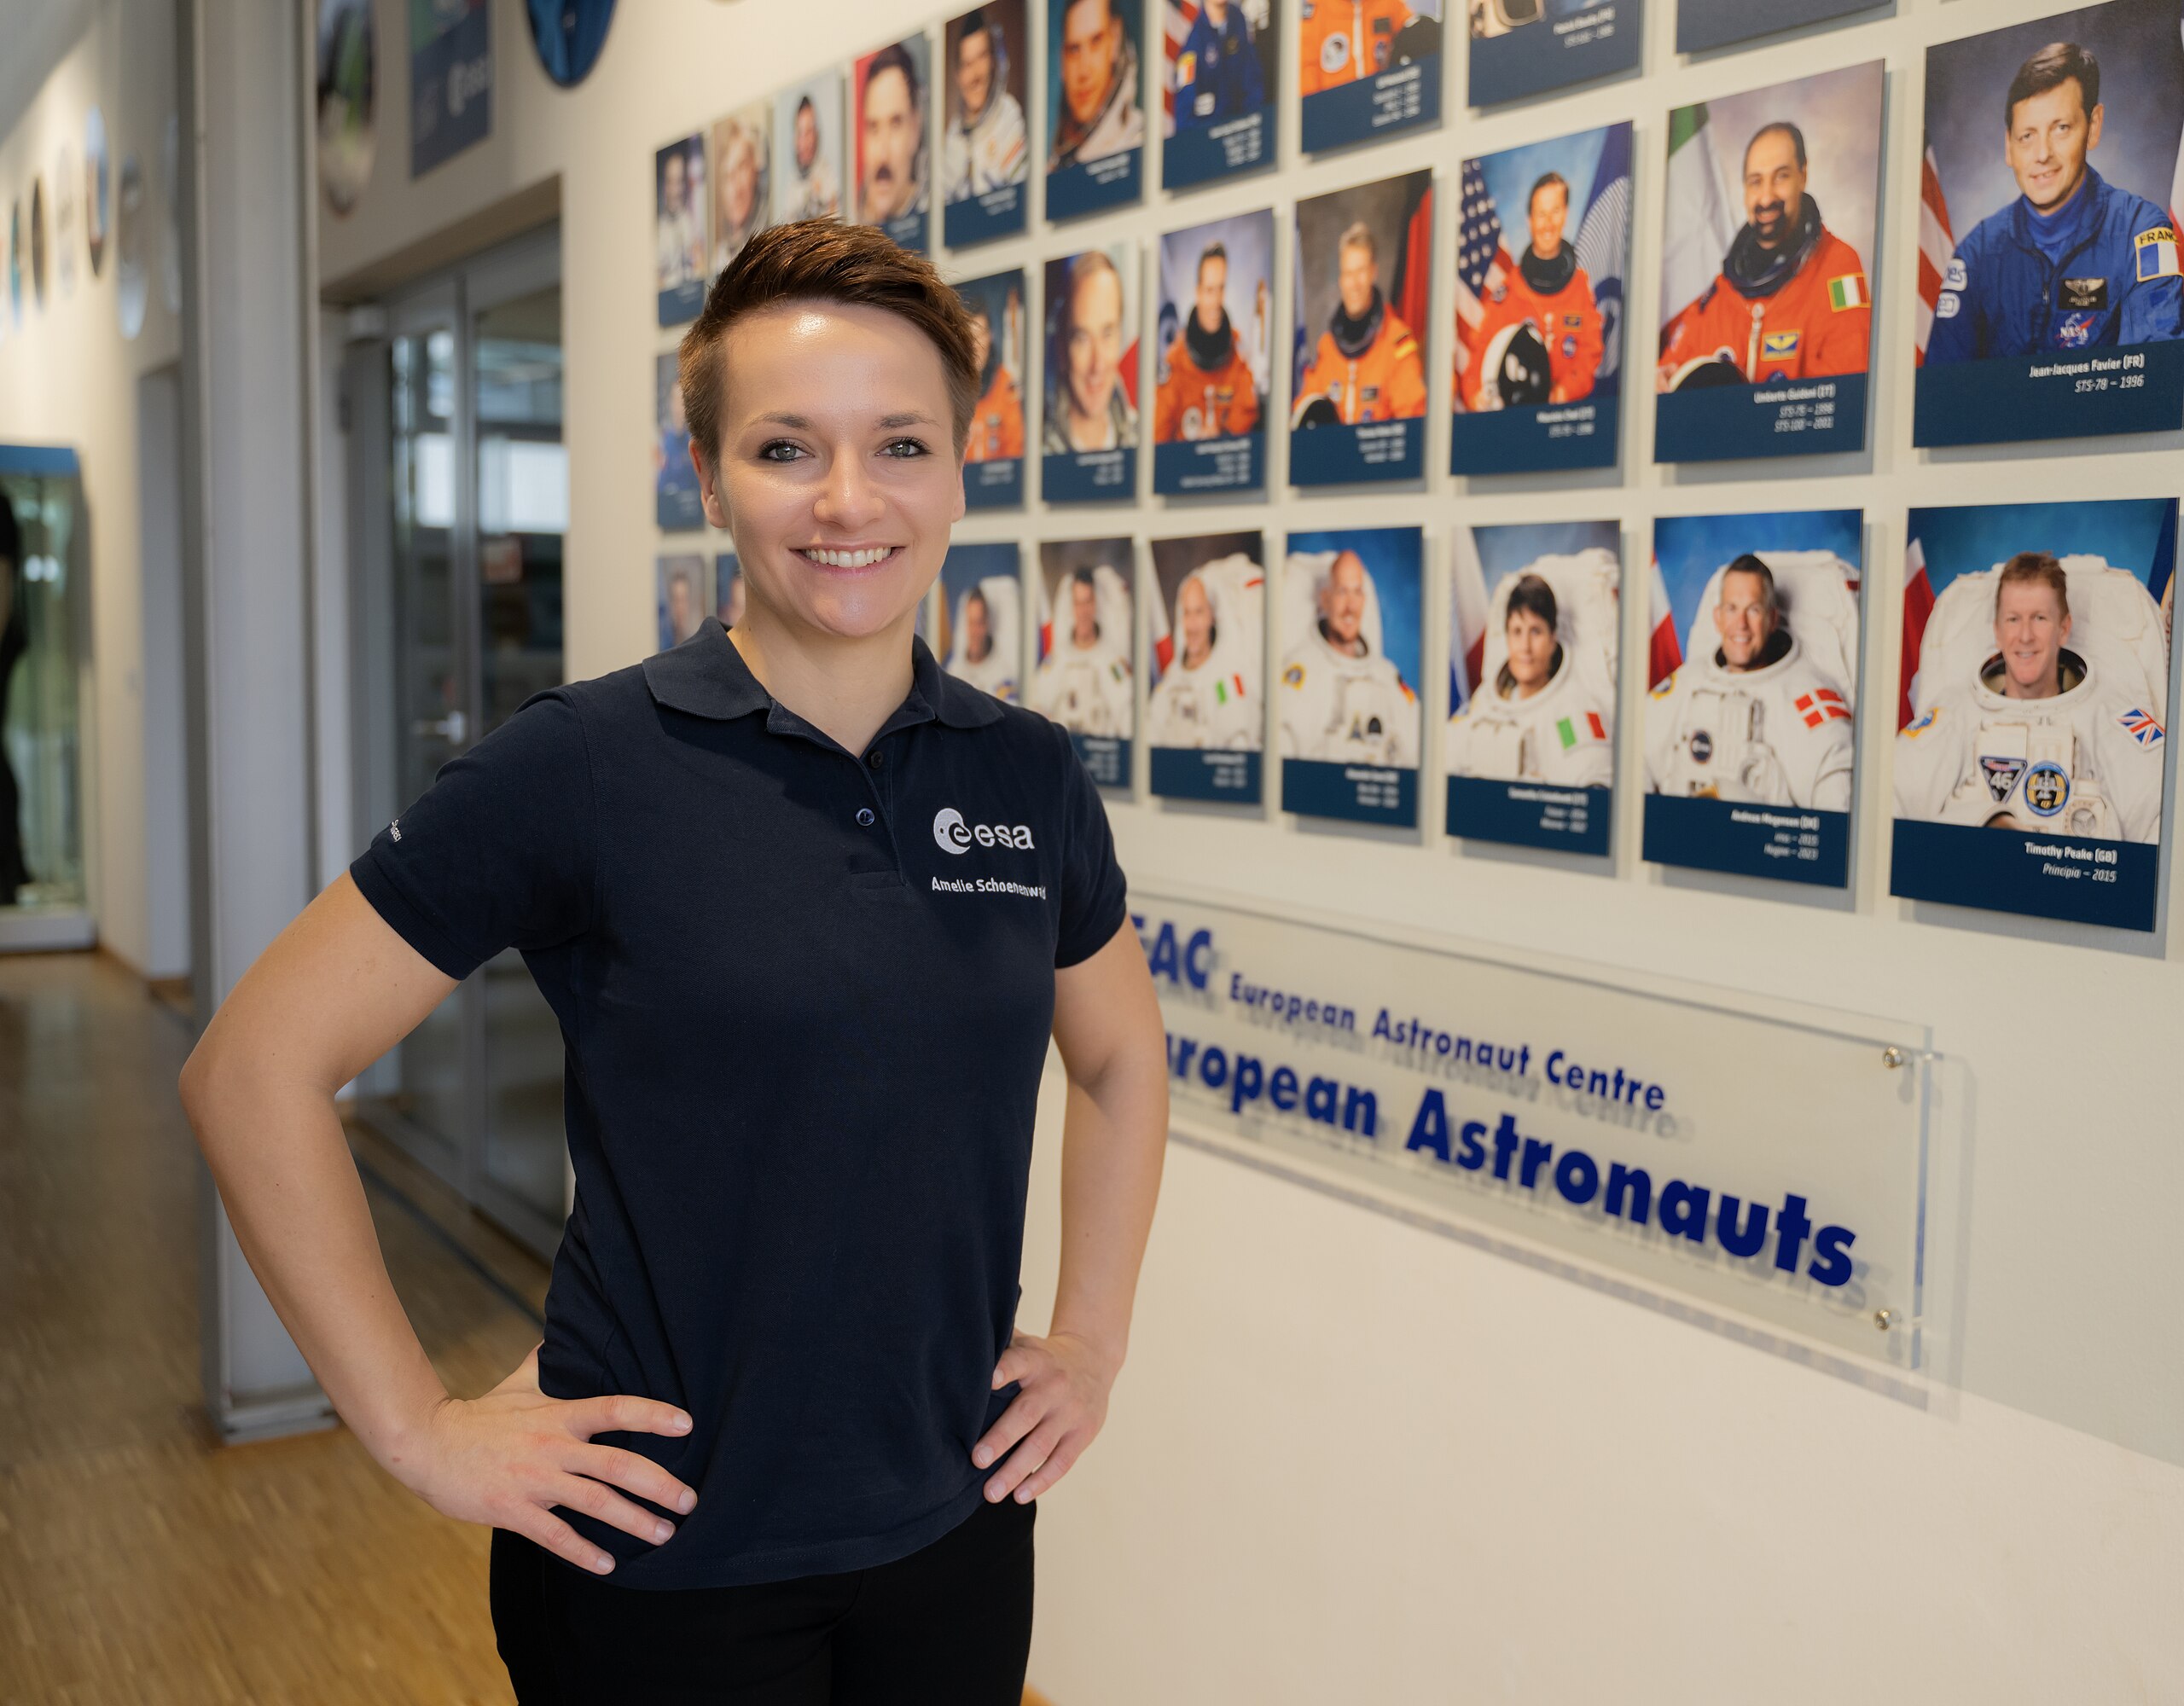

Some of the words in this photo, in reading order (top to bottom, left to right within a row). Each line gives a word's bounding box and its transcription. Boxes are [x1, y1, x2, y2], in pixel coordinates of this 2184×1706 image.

[2029, 362, 2089, 378] Jean-Jacques
[2091, 357, 2122, 372] Favier
[2123, 352, 2146, 369] (FR)
[2074, 378, 2108, 392] STS-78
[2119, 374, 2146, 389] 1996
[1989, 771, 2014, 791] 46
[974, 824, 1035, 850] esa
[2024, 841, 2064, 860] Timothy
[2065, 846, 2094, 861] Peake
[2094, 847, 2117, 865] (GB)
[2042, 862, 2082, 879] Principia
[2092, 868, 2117, 883] 2015
[932, 876, 974, 893] Amelie
[976, 877, 1046, 900] Schoenenw
[1131, 914, 1212, 989] AC
[1230, 972, 1355, 1031] European
[1372, 1007, 1531, 1077] Astronaut
[1545, 1050, 1666, 1111] Centre
[1165, 1033, 1379, 1139] ropean
[1405, 1088, 1857, 1286] Astronauts
